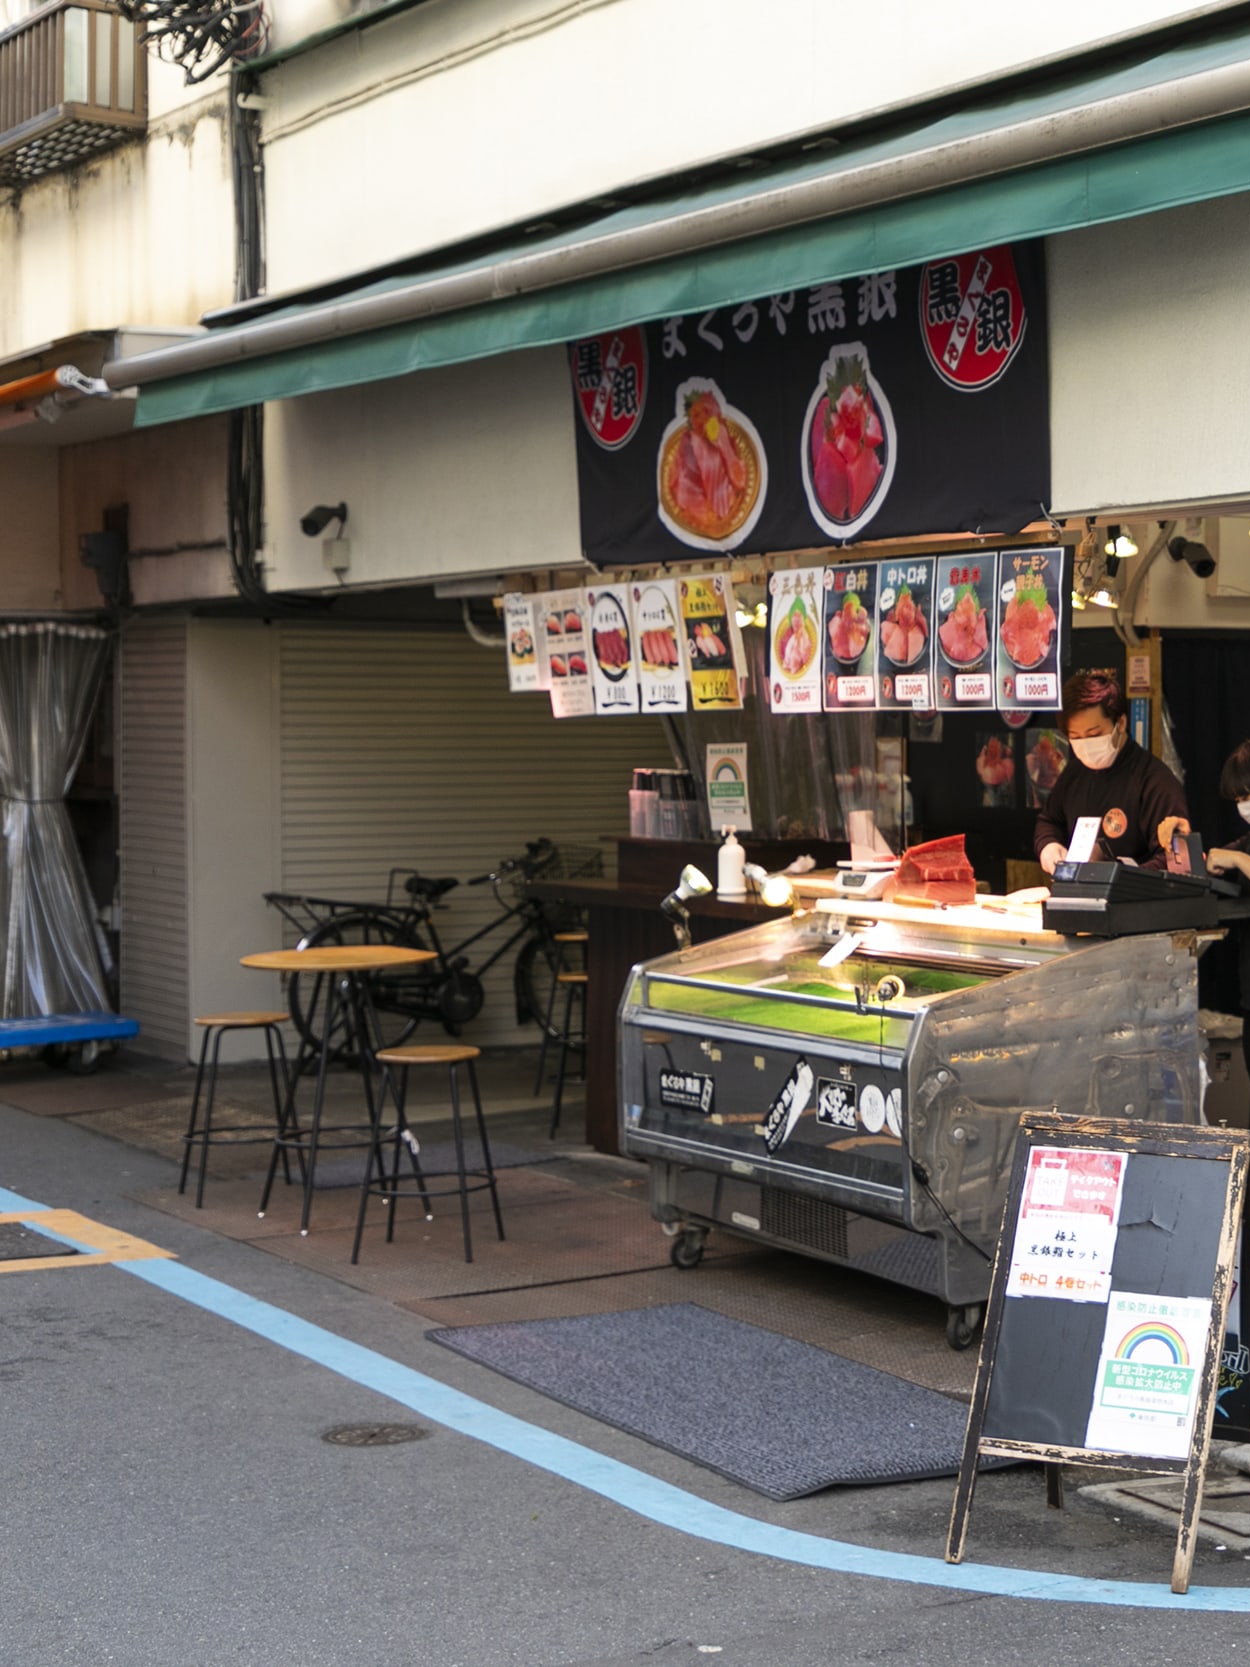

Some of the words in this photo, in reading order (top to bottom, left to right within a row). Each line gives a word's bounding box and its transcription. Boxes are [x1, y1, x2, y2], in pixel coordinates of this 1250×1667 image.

[927, 261, 961, 327] 黒
[975, 289, 1012, 355] 銀
[1012, 555, 1049, 572] サーモン
[834, 568, 868, 593] 紅白丼
[887, 566, 928, 586] 中トロ丼
[961, 683, 985, 696] 1000円
[1024, 683, 1049, 696] 1000円
[1019, 1271, 1048, 1286] 中トロ
[1111, 1363, 1189, 1382] 新型コロナウイルス
[1114, 1375, 1183, 1392] 感染拡大防止中
